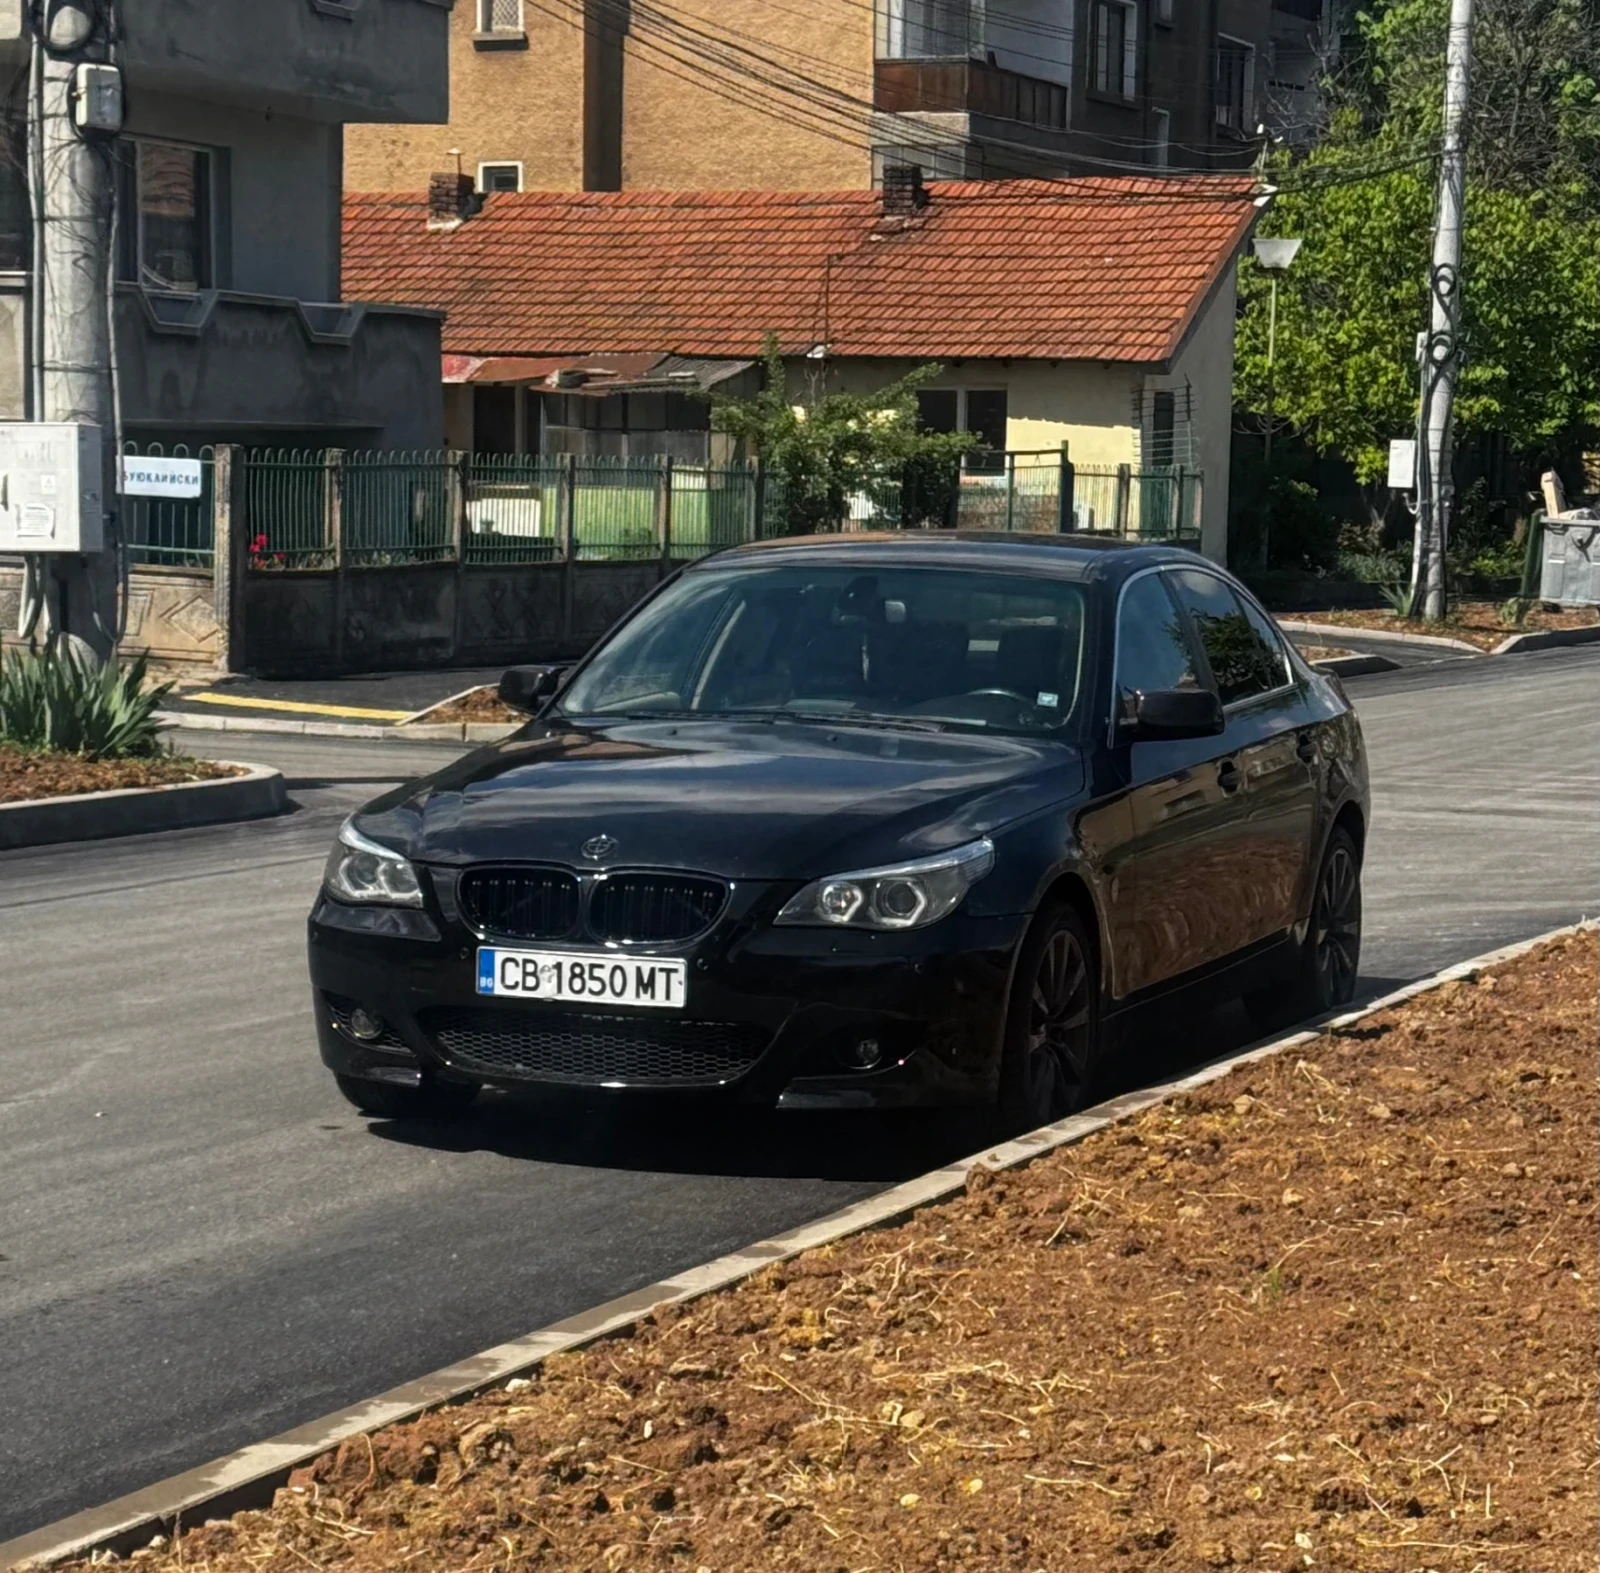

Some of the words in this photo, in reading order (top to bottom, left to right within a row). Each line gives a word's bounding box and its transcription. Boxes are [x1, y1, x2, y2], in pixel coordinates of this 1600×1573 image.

[479, 976, 494, 988] BG
[500, 956, 541, 992] CB
[551, 961, 628, 998] 1850
[635, 965, 679, 1001] MT
